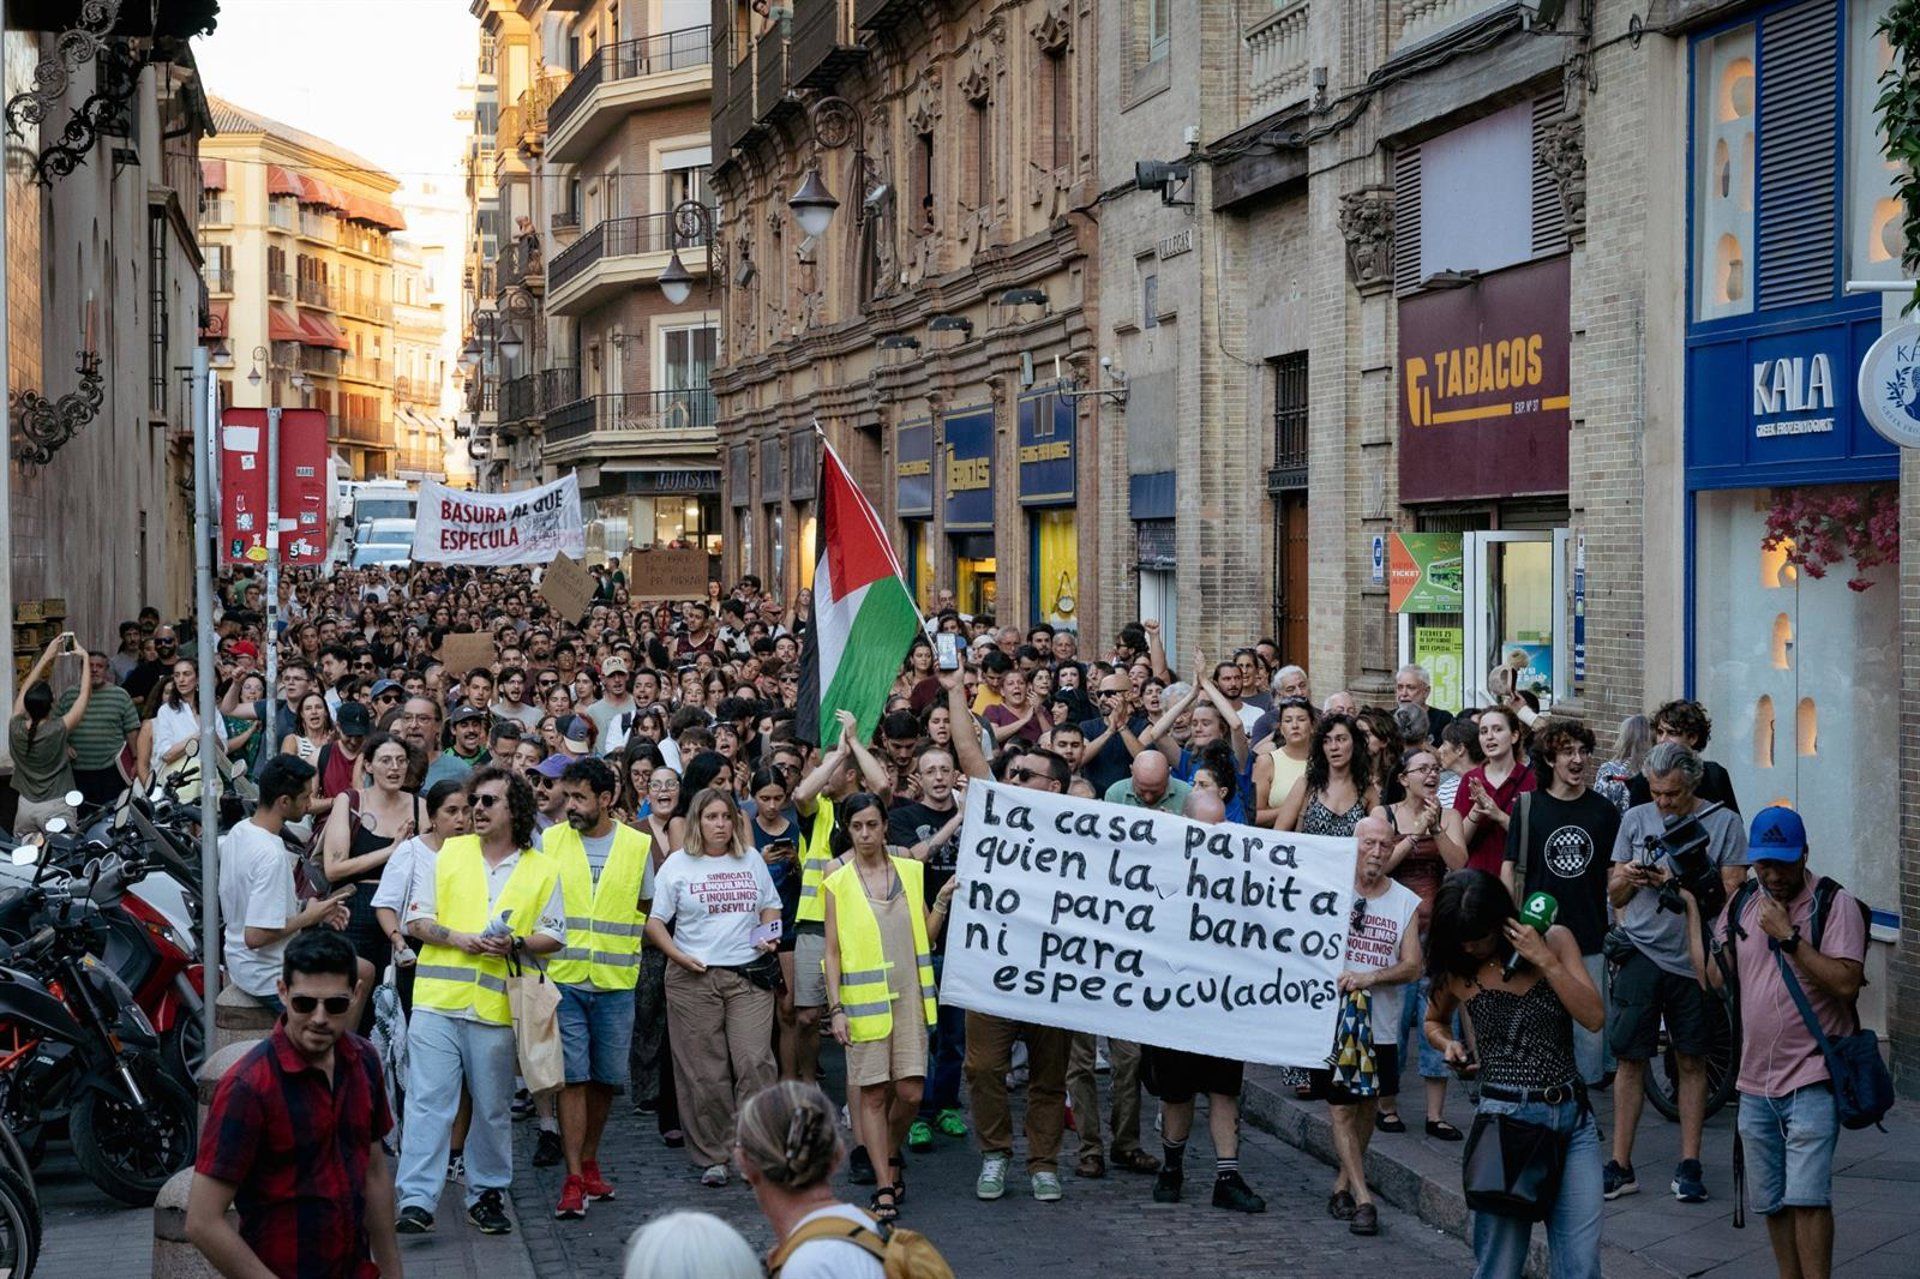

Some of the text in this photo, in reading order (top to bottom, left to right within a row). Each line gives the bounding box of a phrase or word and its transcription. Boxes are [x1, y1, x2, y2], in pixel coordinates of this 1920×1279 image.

[1434, 333, 1543, 399] TABACOS
[1753, 353, 1834, 415] KALA
[440, 489, 563, 524] BASURA AL QUE
[440, 527, 519, 551] ESPECULA
[984, 789, 1299, 869] La casa para
[706, 880, 757, 891] INQUILINAS
[707, 871, 753, 881] SINDICATO
[975, 835, 1339, 917] quien la habita
[699, 891, 758, 903] E INQUILINOS
[708, 903, 756, 914] DE SEVILLA
[969, 880, 1342, 961] no para bancos
[965, 921, 1145, 978] ni para
[1347, 937, 1393, 956] NQUILINOS
[993, 965, 1337, 1012] especuculadores
